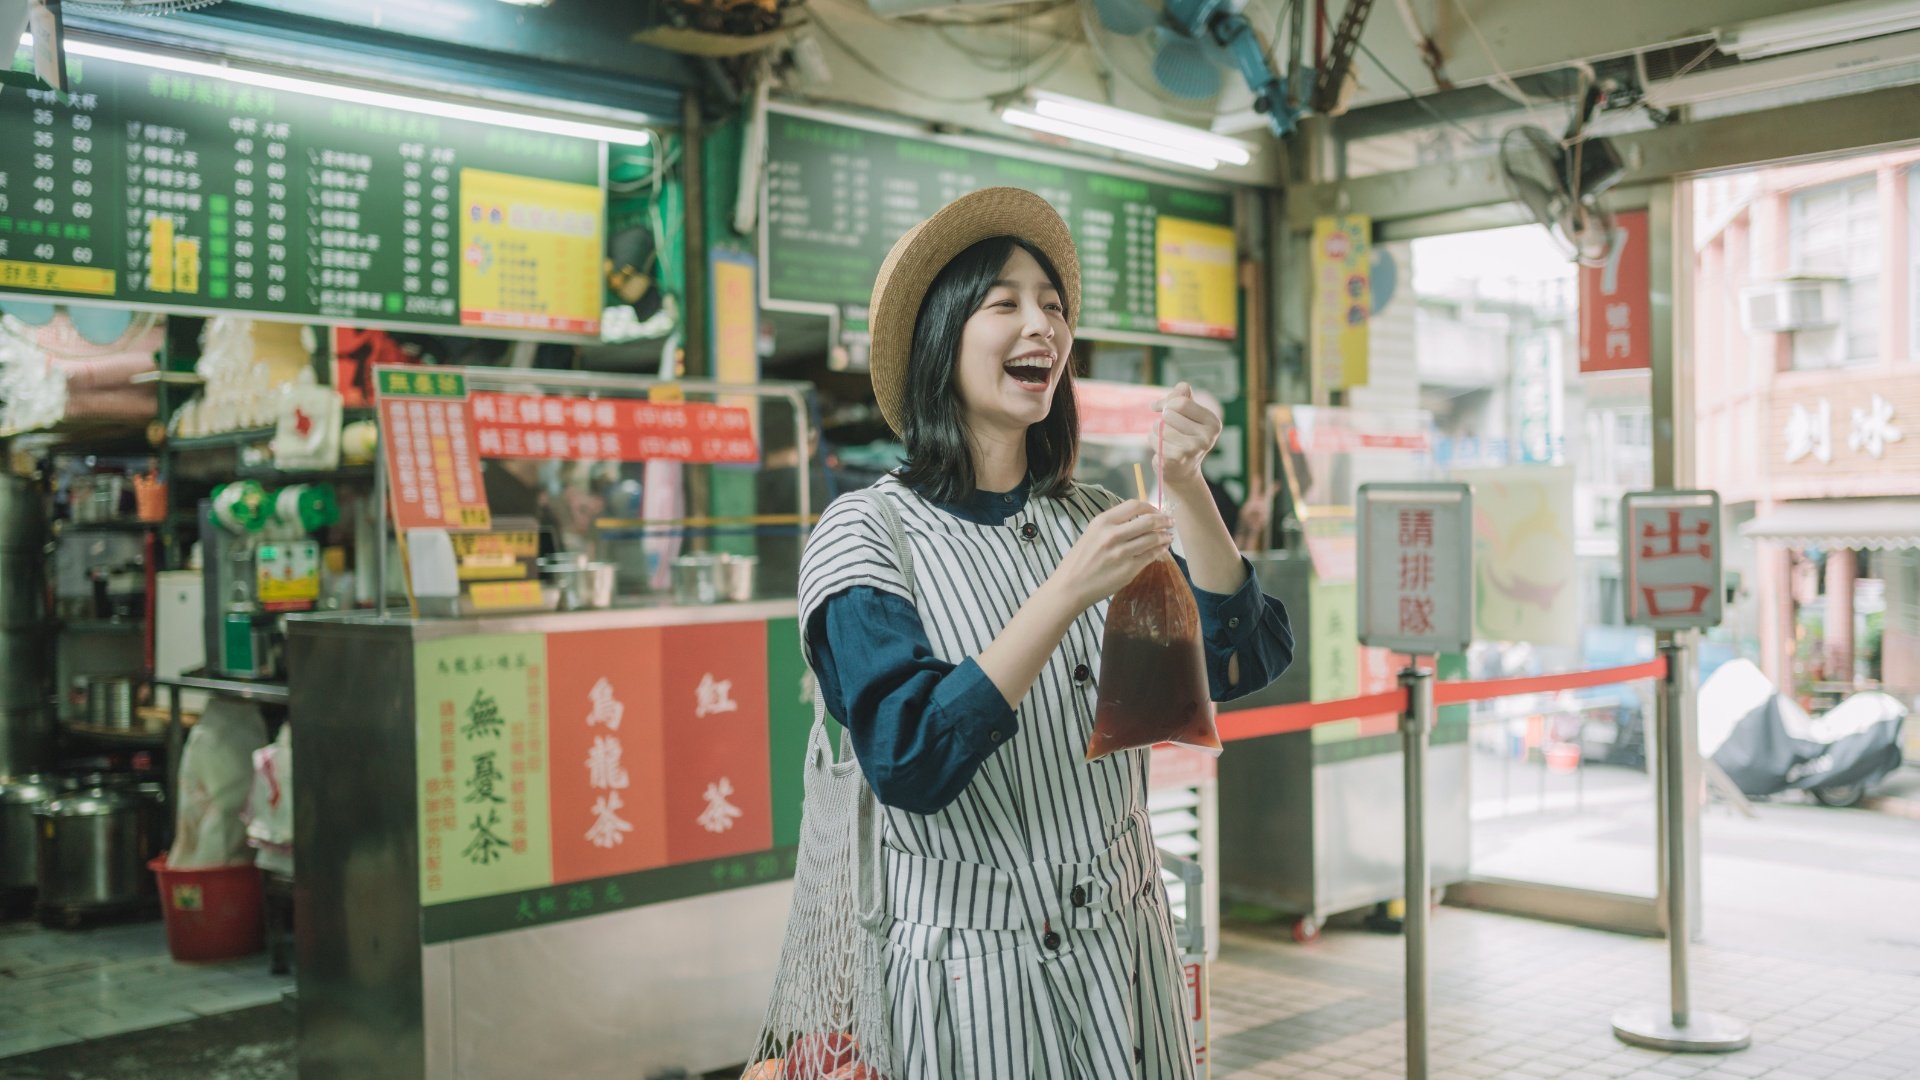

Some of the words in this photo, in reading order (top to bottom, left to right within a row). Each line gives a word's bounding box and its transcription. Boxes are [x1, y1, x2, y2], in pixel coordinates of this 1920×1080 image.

[33, 108, 54, 125] 35
[72, 114, 92, 131] 50
[33, 131, 54, 148] 35
[72, 136, 92, 153] 50
[33, 153, 54, 170] 35
[72, 158, 92, 175] 50
[33, 176, 54, 192] 40
[72, 179, 92, 197] 60
[33, 198, 54, 215] 40
[72, 201, 92, 218] 60
[34, 243, 54, 259] 40
[72, 247, 92, 263] 60
[1397, 509, 1435, 635] 請排隊
[1641, 511, 1712, 617] 出口
[584, 676, 633, 848] 烏龍茶
[694, 672, 743, 833] 紅茶
[460, 688, 510, 865] 無憂茶
